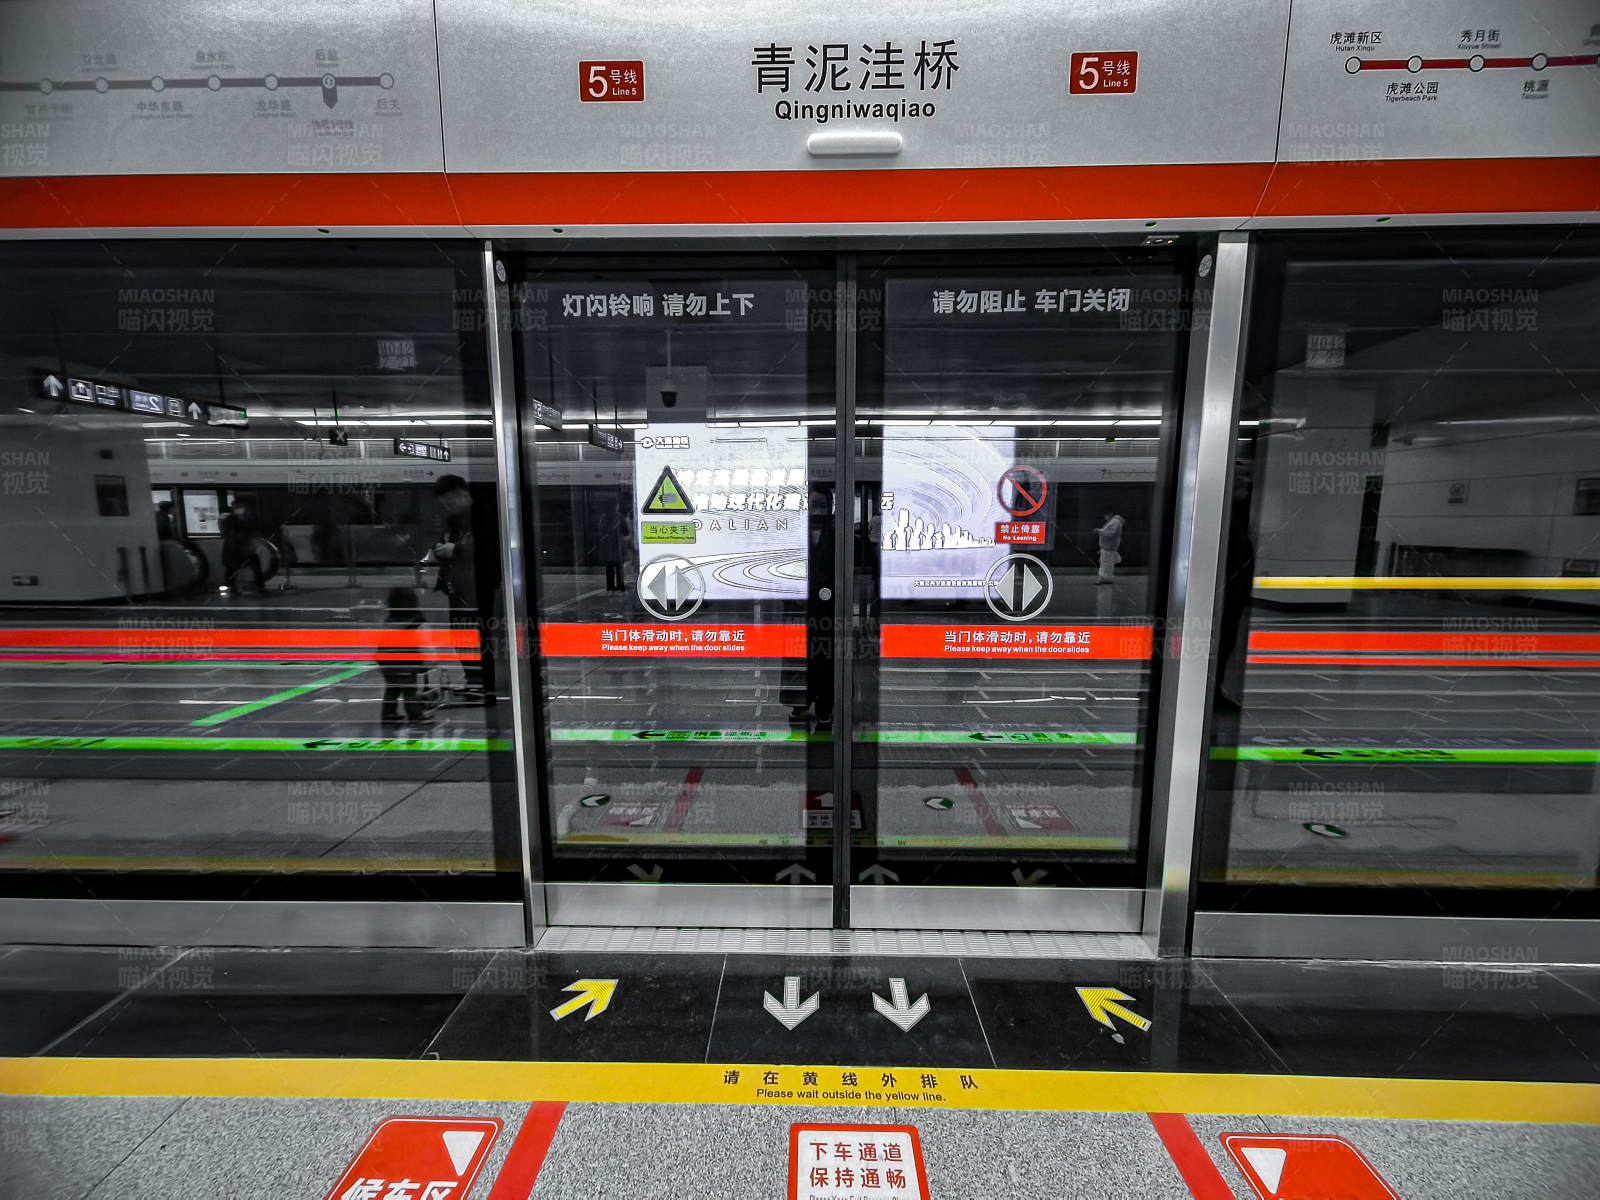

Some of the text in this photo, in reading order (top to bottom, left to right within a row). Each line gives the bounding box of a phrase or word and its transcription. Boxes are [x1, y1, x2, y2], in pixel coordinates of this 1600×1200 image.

[1330, 31, 1383, 45] 虎滩新区
[1460, 29, 1500, 43] 秀月街
[751, 39, 960, 93] 青泥洼桥
[1079, 57, 1131, 90] 5号线
[588, 65, 638, 98] 5号线
[612, 87, 637, 96] Line 5
[1103, 78, 1129, 88] Line 5
[1386, 81, 1439, 95] 虎滩公园
[775, 98, 936, 124] Qingniwaqiao
[562, 292, 754, 318] 灯闪铃响 请勿上下
[932, 288, 1131, 314] 请勿阻止 车门关闭
[649, 525, 689, 535] 当心夹手
[628, 644, 647, 652] keep
[648, 644, 668, 652] away
[944, 645, 1090, 654] Please keep away when the door slides
[724, 1070, 979, 1090] 请在黄线外排队
[756, 1088, 947, 1103] Please wait outside the yellow line.
[809, 1142, 903, 1163] 下车通道
[809, 1167, 906, 1189] 保持通畅
[341, 1177, 459, 1200] 候车区
